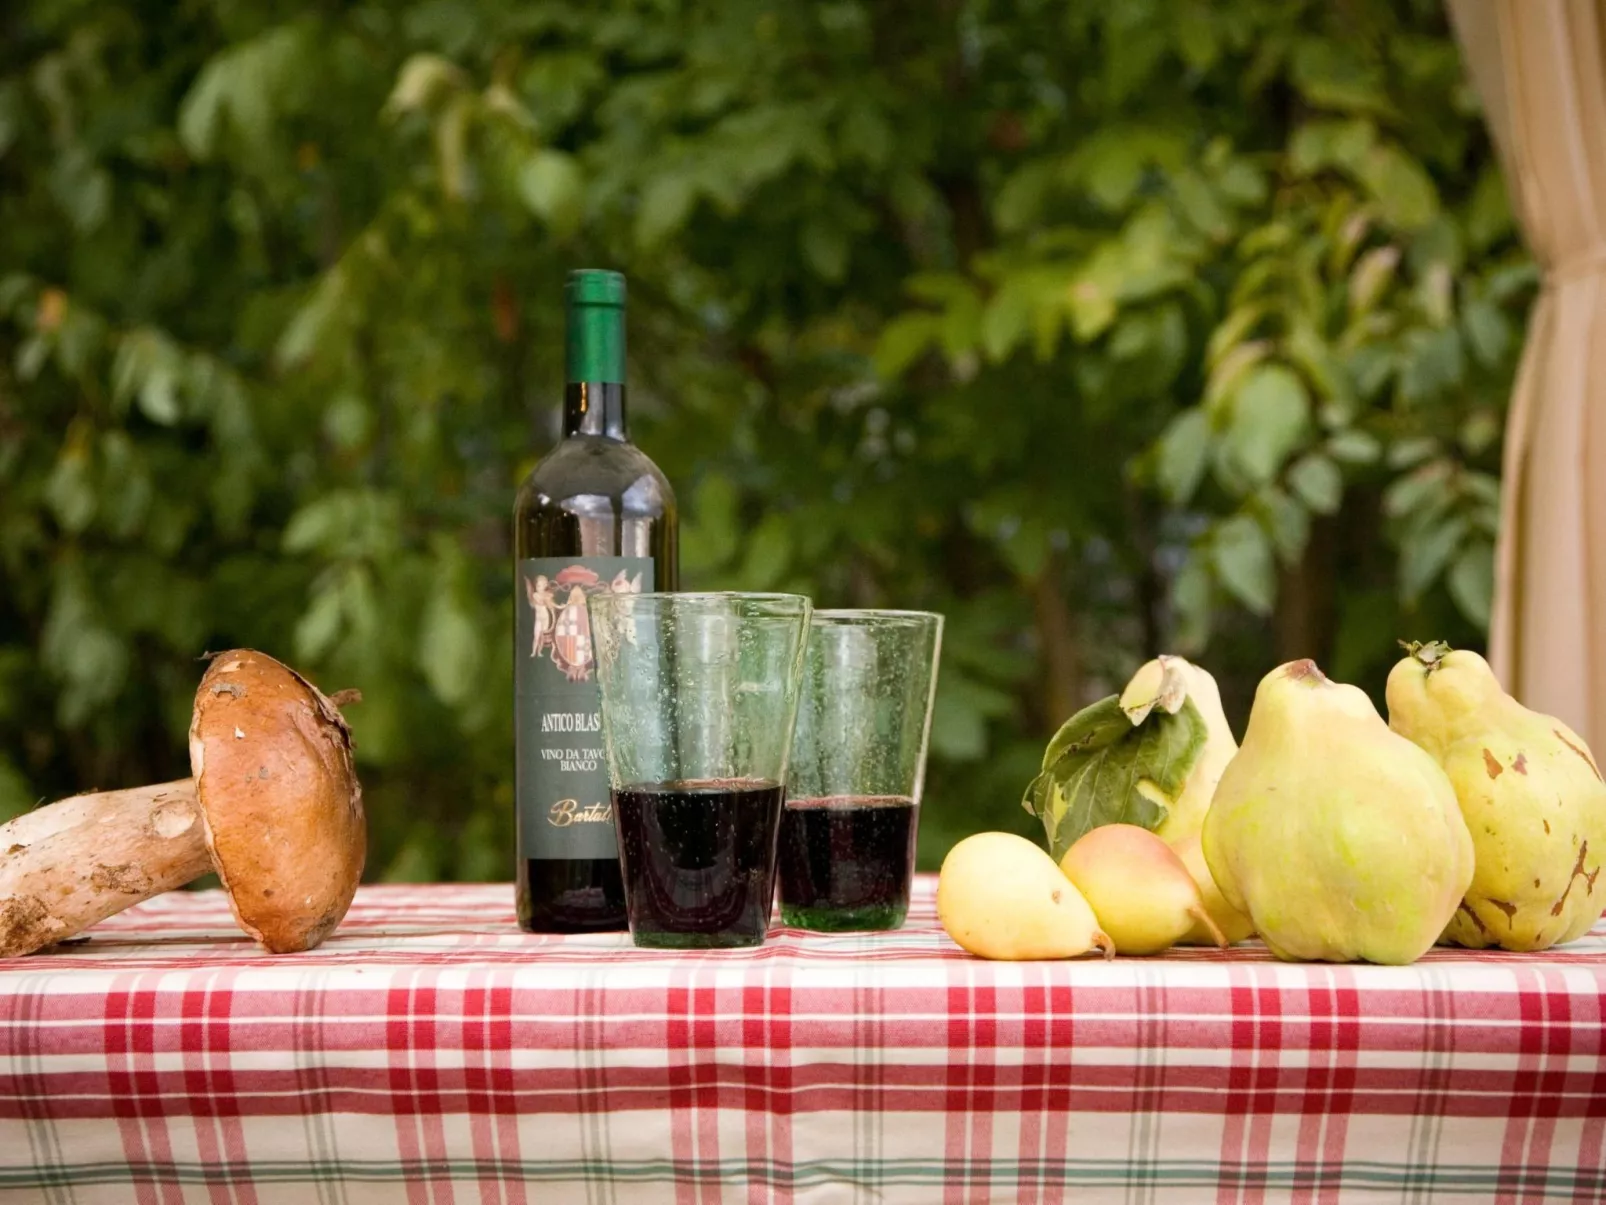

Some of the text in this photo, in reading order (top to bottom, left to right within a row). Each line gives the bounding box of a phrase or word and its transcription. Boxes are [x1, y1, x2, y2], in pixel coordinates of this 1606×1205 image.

[541, 713, 573, 732] ANTICO
[541, 748, 563, 760] VINO
[565, 748, 580, 760] DA
[560, 760, 597, 772] BIANCO
